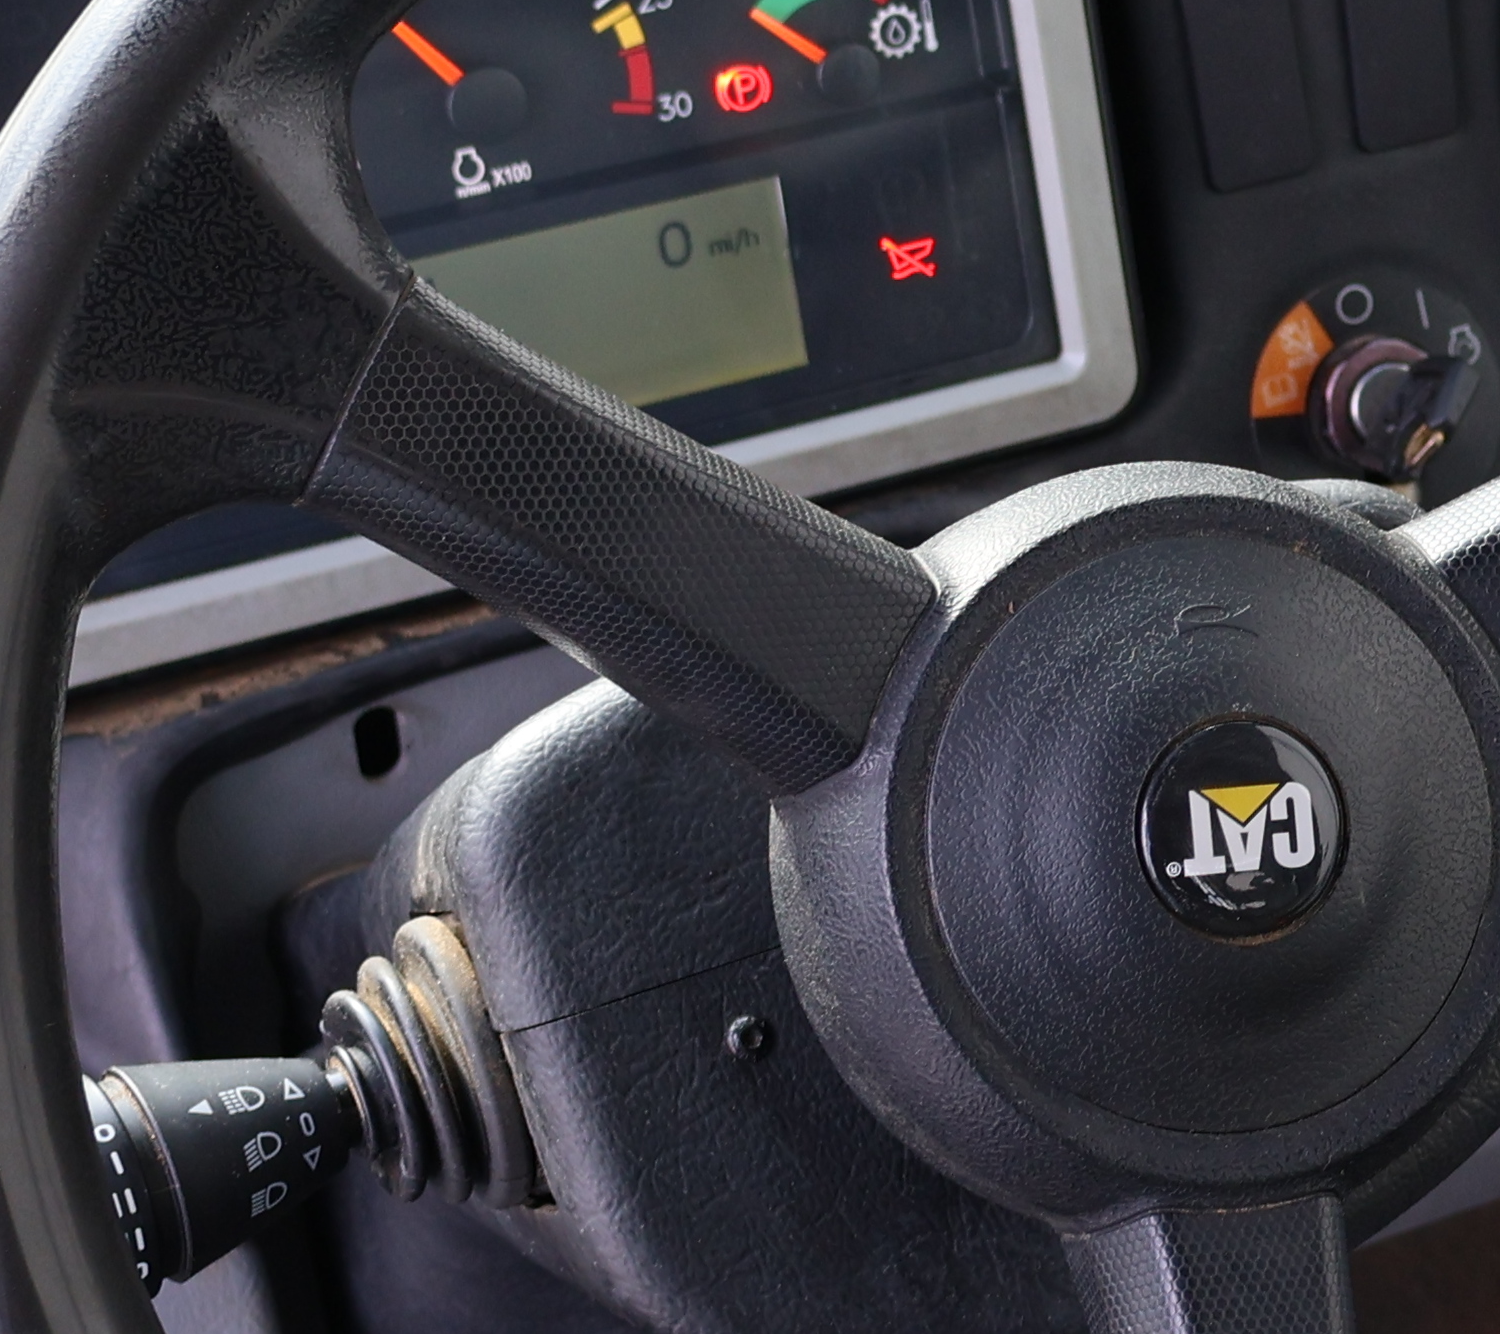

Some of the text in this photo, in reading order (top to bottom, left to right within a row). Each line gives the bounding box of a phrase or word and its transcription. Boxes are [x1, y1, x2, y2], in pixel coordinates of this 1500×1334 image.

[657, 91, 694, 122] 30
[490, 160, 533, 188] X100
[658, 221, 692, 268] 0
[1183, 781, 1316, 878] CAT
